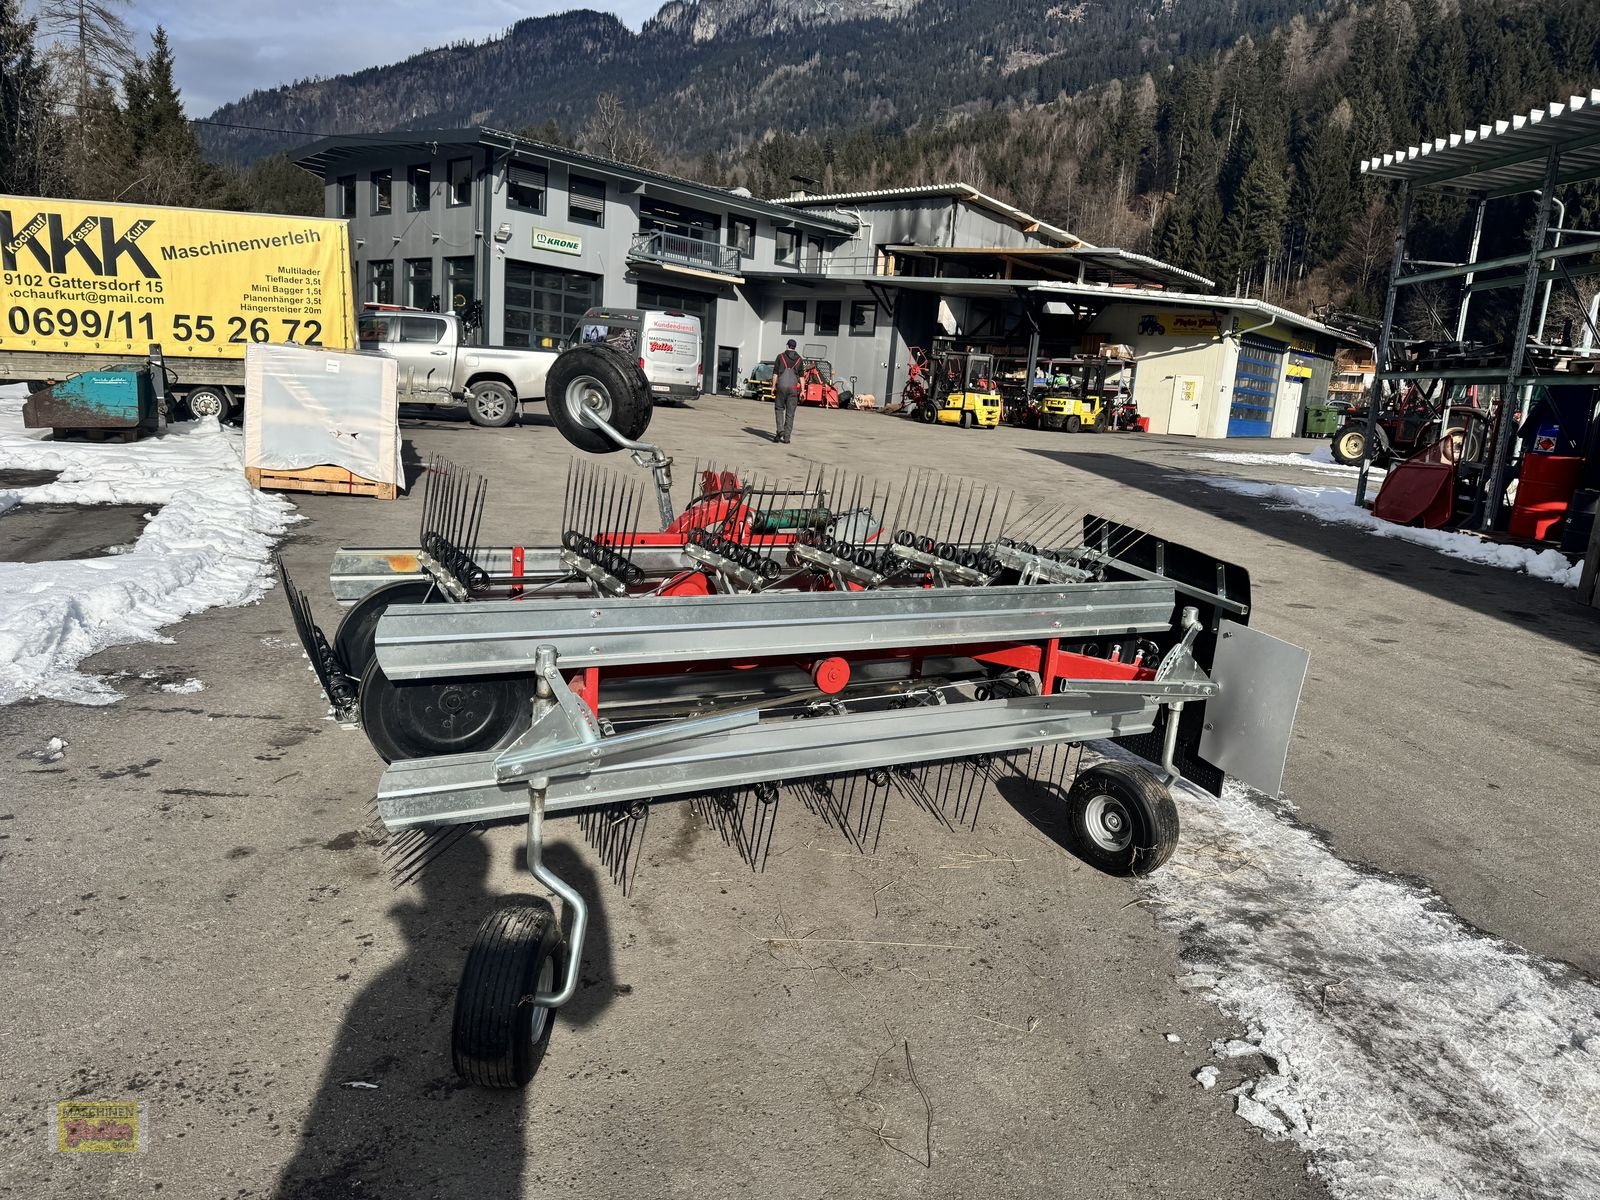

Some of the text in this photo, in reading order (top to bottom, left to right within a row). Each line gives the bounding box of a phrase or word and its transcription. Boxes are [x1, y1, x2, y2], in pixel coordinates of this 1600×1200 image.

[5, 215, 47, 254] Kochauf
[67, 217, 97, 246] Kassl
[124, 220, 149, 243] Kurt
[160, 228, 321, 260] Maschinenverleih
[547, 237, 579, 250] KRONE
[277, 266, 321, 276] Multilader
[4, 273, 163, 293] 9102 Gattersdorf 15
[265, 275, 321, 286] Tieflader 3,5t
[251, 284, 322, 296] Mini Bagger 1,5t
[243, 294, 322, 306] Planenhänger 3,5t
[240, 303, 322, 315] Hängersteiger 20m
[8, 306, 323, 347] 0699/11 55 26 72
